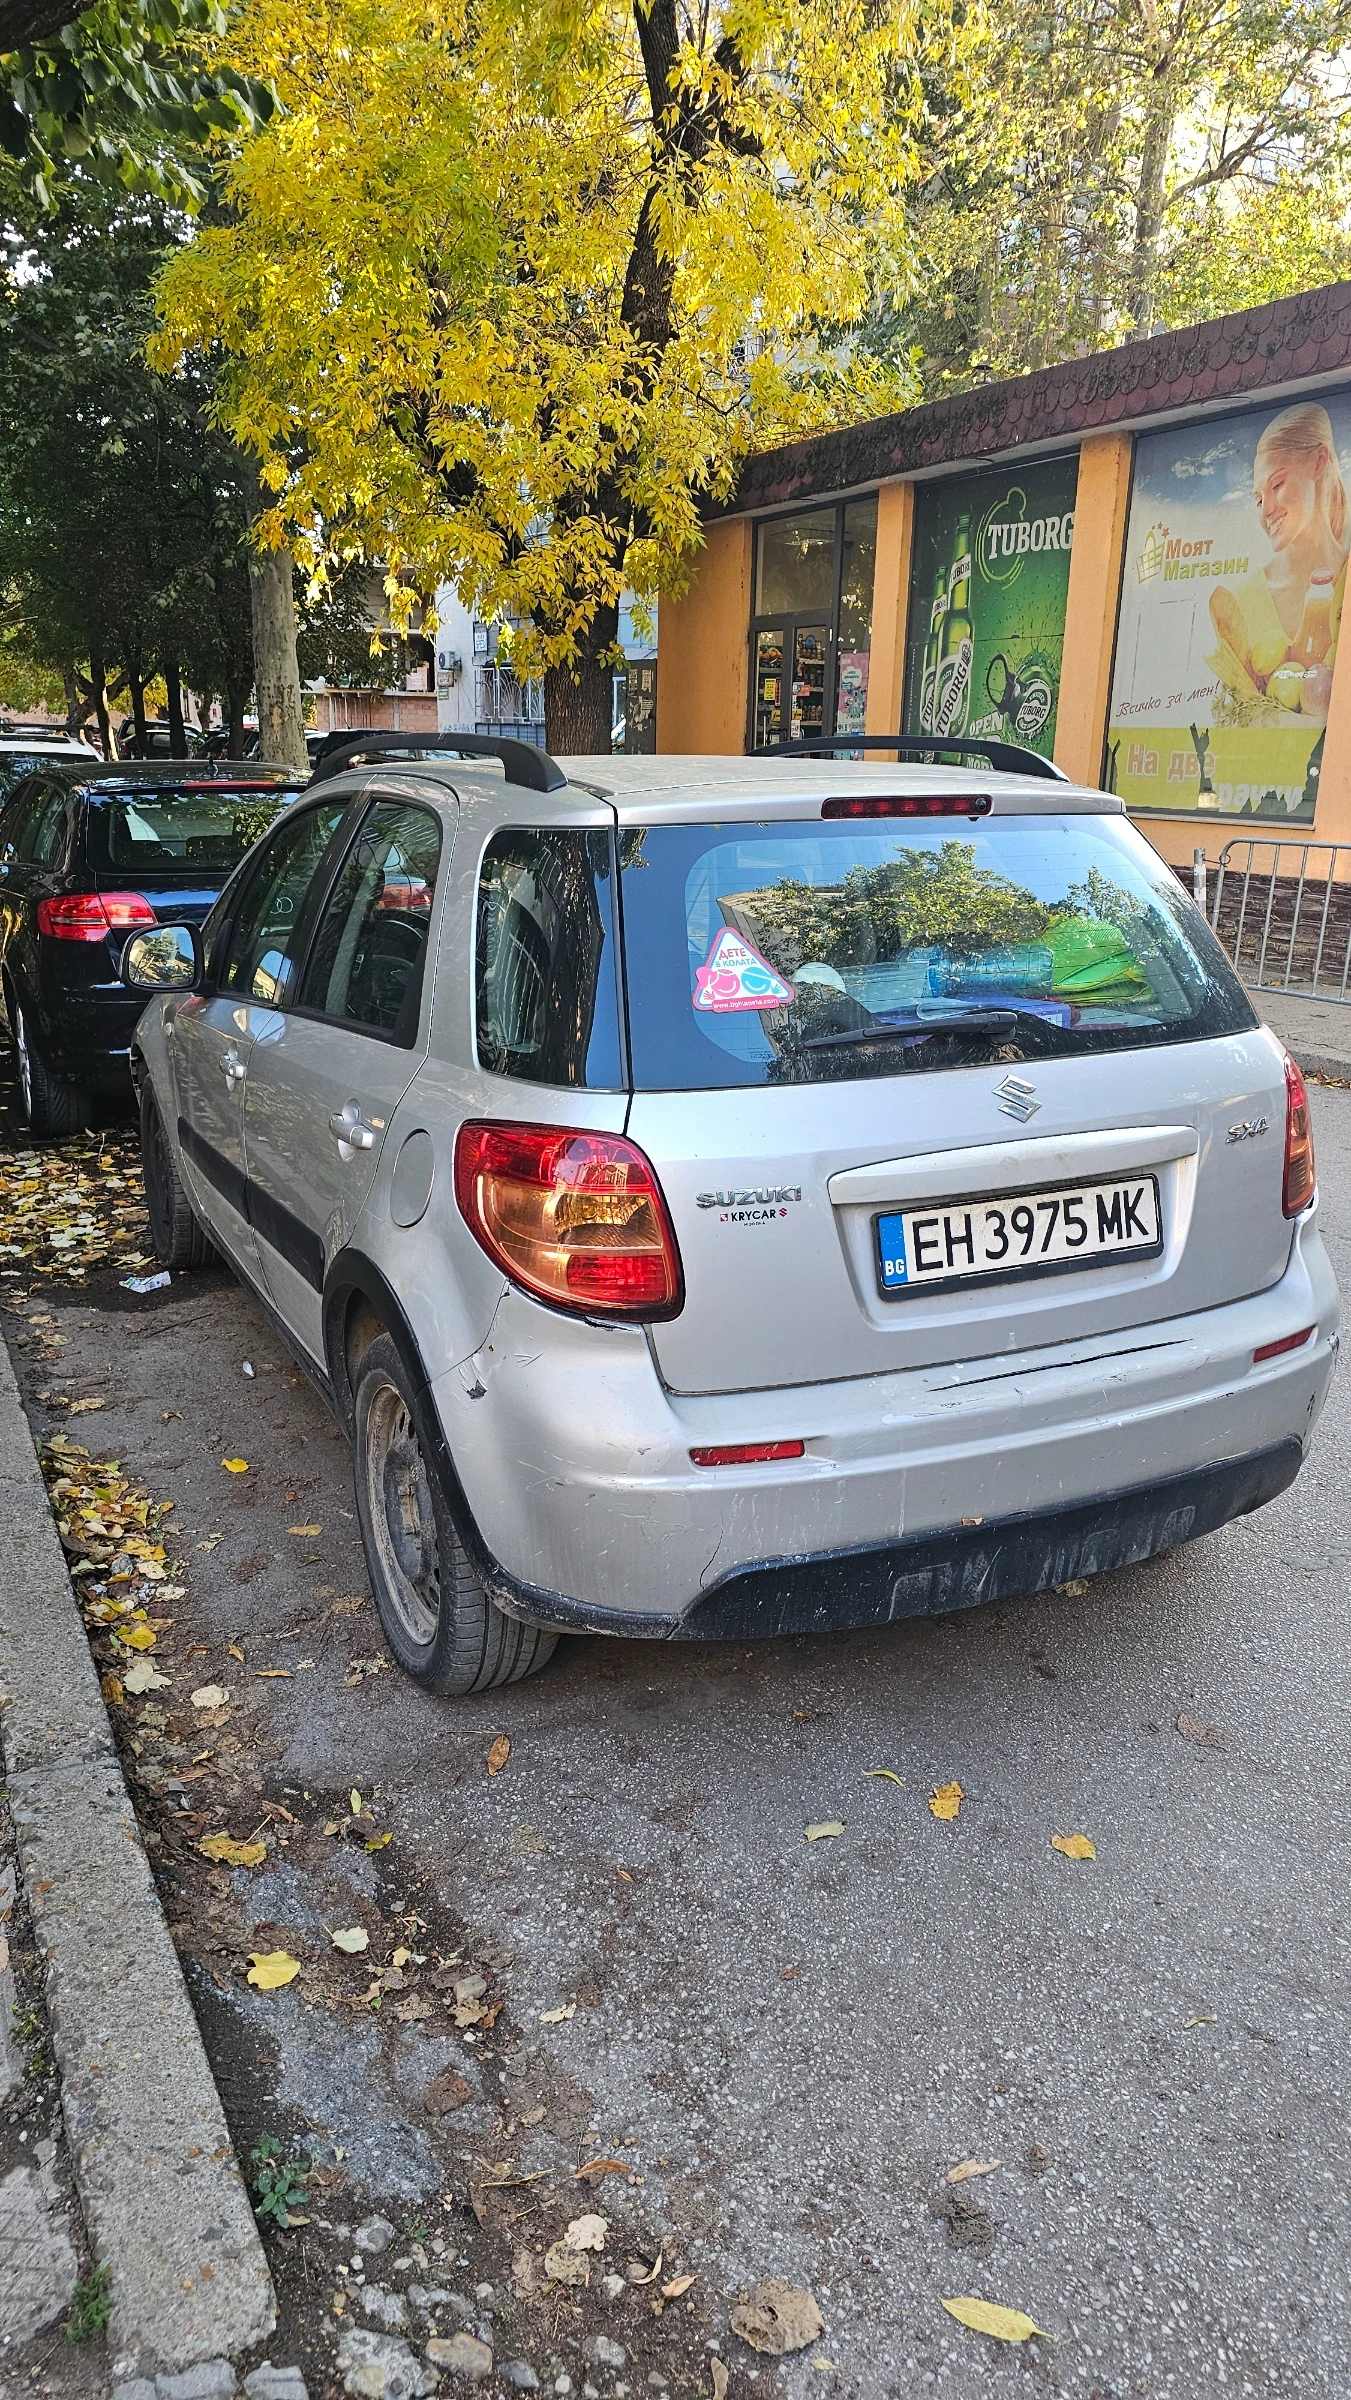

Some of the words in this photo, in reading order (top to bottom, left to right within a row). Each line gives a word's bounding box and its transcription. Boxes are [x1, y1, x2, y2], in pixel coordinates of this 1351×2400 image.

[987, 511, 1076, 561] TUBORG
[1165, 538, 1214, 560] Моят
[1163, 556, 1250, 582] Магазин
[935, 662, 967, 736] TUBORG
[1115, 696, 1162, 718] Всичко
[1165, 694, 1182, 709] за
[1186, 680, 1221, 703] мен!
[969, 710, 1004, 737] OPEN
[1126, 743, 1160, 776] На
[1167, 750, 1216, 783] две
[718, 947, 747, 961] ДЕТЕ
[723, 958, 757, 967] КОЛАТА
[1225, 1116, 1270, 1145] SX4
[695, 1184, 802, 1209] SUZUKI
[731, 1209, 777, 1222] KRYCAR
[912, 1213, 975, 1272] EH
[985, 1196, 1088, 1260] 3975
[1095, 1187, 1149, 1243] MK
[884, 1259, 905, 1276] BG
